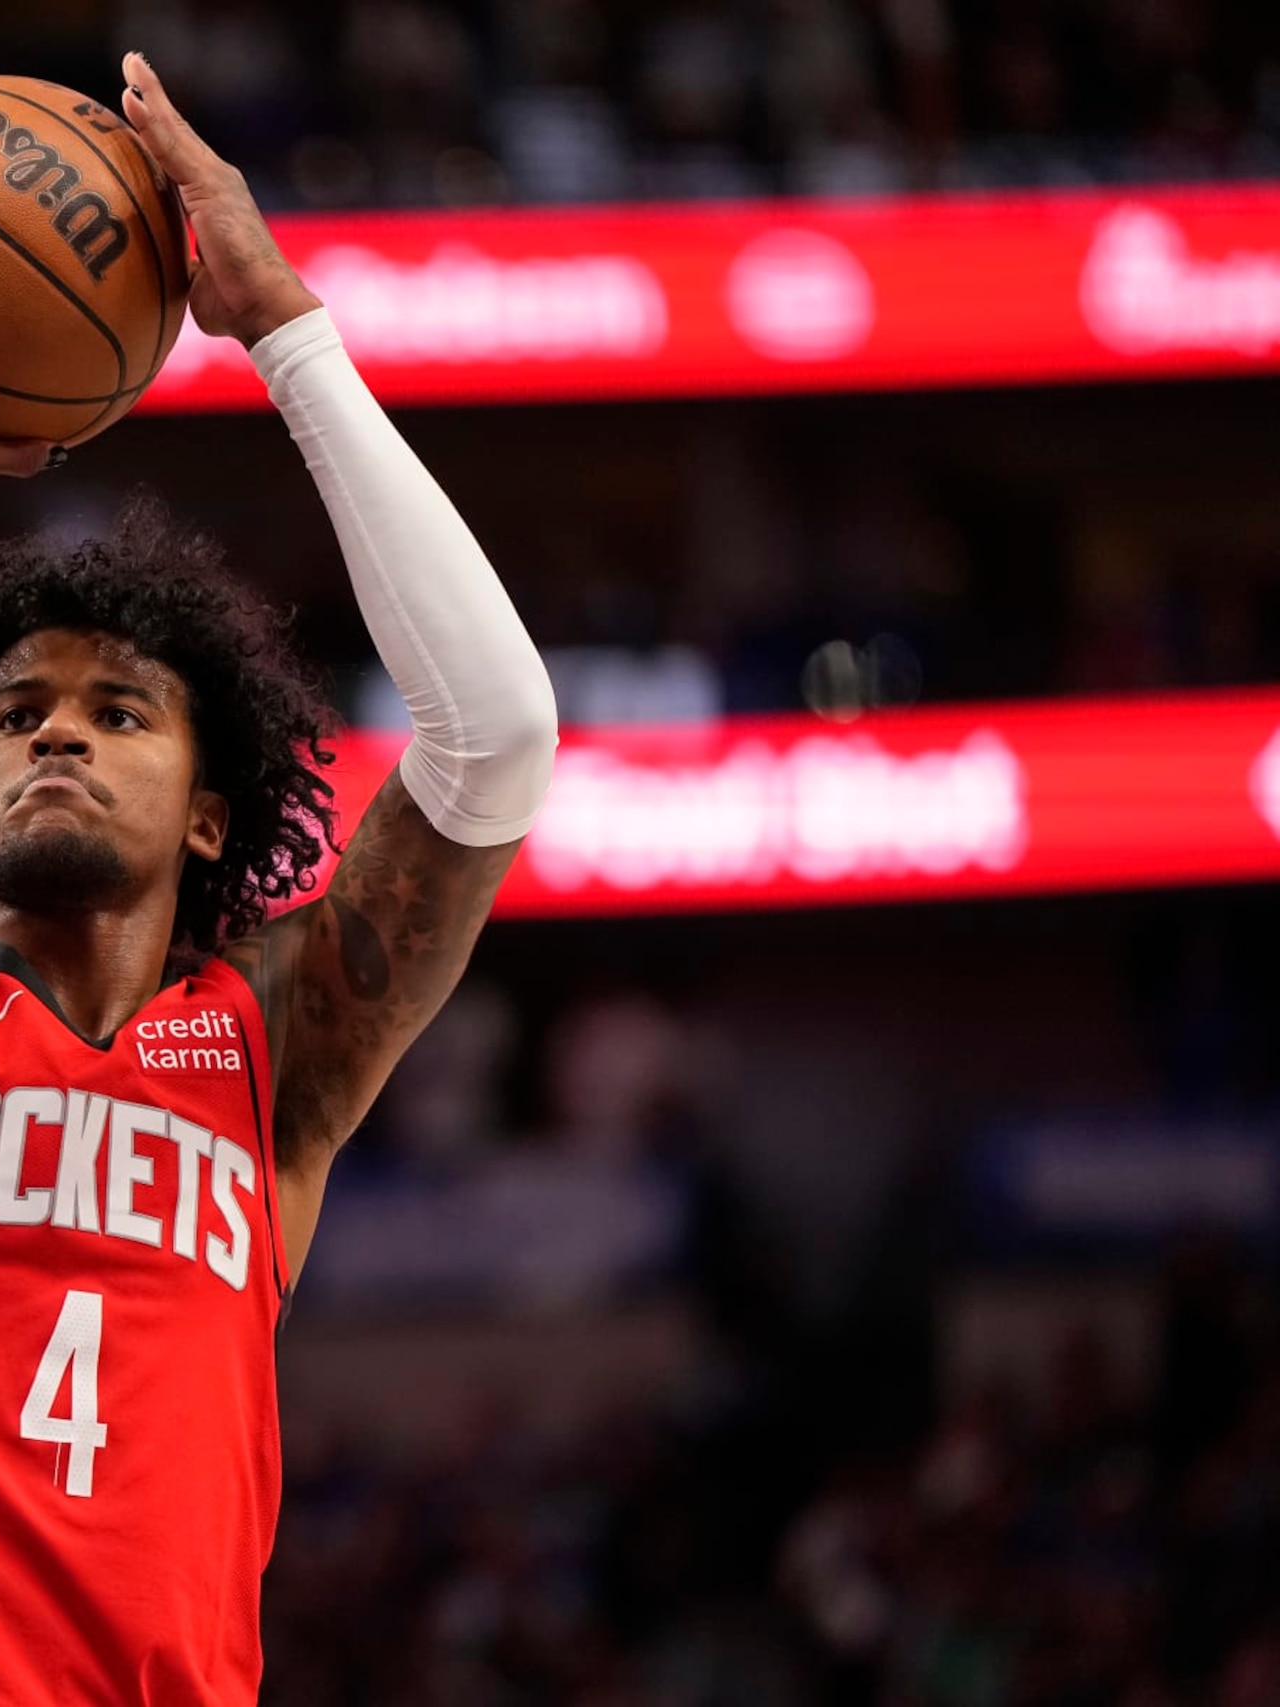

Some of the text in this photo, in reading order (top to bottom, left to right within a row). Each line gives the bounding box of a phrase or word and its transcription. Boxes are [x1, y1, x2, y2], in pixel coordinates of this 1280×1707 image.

[136, 1010, 238, 1040] credit
[136, 1041, 241, 1071] karma
[20, 1289, 108, 1498] 4
